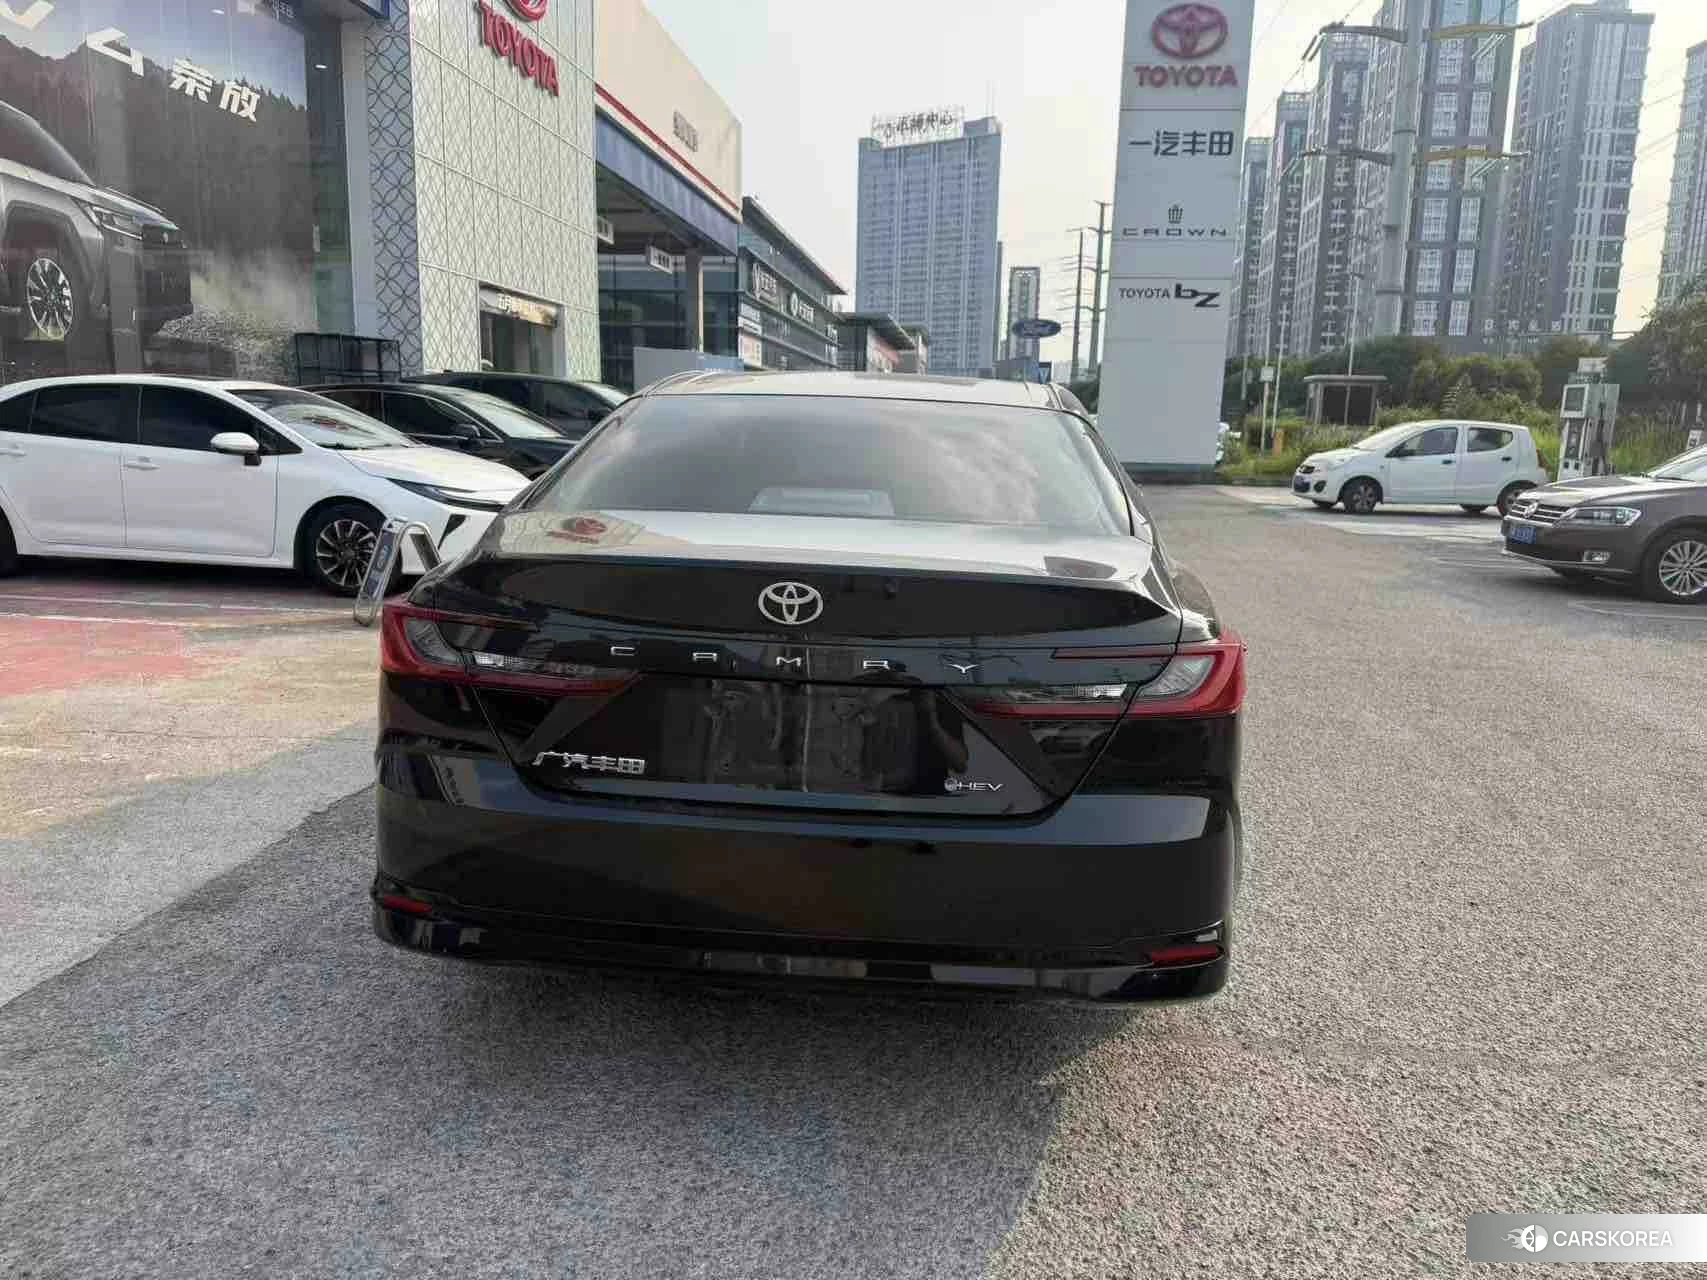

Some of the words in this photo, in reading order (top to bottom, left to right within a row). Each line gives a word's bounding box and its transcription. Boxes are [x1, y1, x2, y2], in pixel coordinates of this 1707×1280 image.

[479, 0, 560, 97] TOYOTA
[1134, 65, 1239, 88] TOYOTA
[169, 56, 261, 122] 荣放
[1128, 130, 1235, 157] 一汽丰田
[1122, 227, 1228, 238] CROWN
[1119, 287, 1171, 299] TOYOTA
[610, 645, 980, 674] CAMRY
[531, 751, 645, 775] 广汽丰田
[959, 781, 1004, 792] HEV
